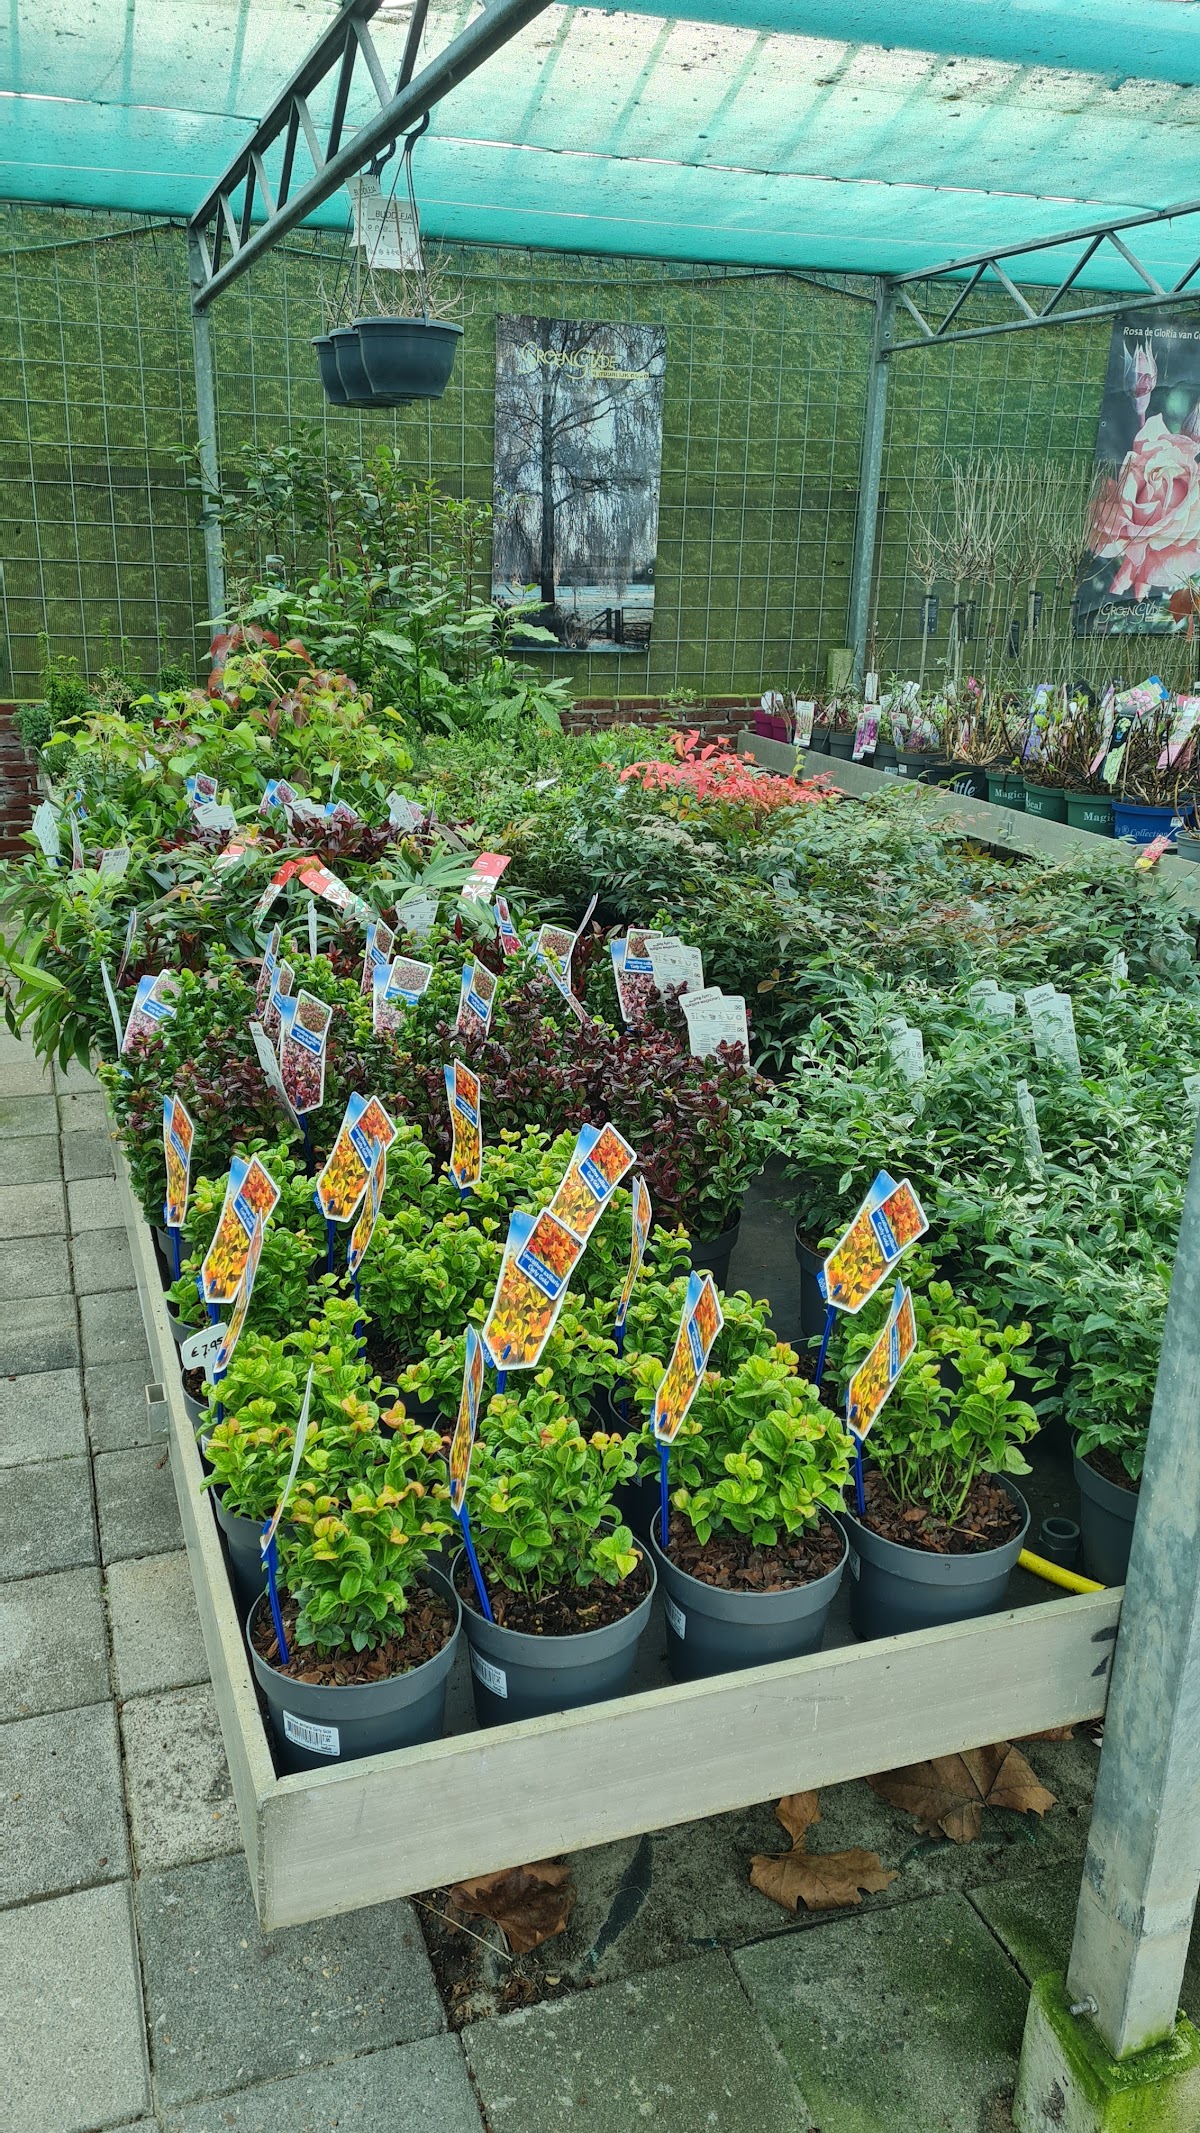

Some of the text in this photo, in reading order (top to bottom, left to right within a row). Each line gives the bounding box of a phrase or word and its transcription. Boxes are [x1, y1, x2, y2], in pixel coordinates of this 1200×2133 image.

[1123, 326, 1143, 336] Rosa
[1145, 327, 1153, 337] de
[1179, 332, 1192, 340] van
[522, 1250, 560, 1287] Leucothoe axillaris
[527, 1263, 550, 1285] Curly Gold
